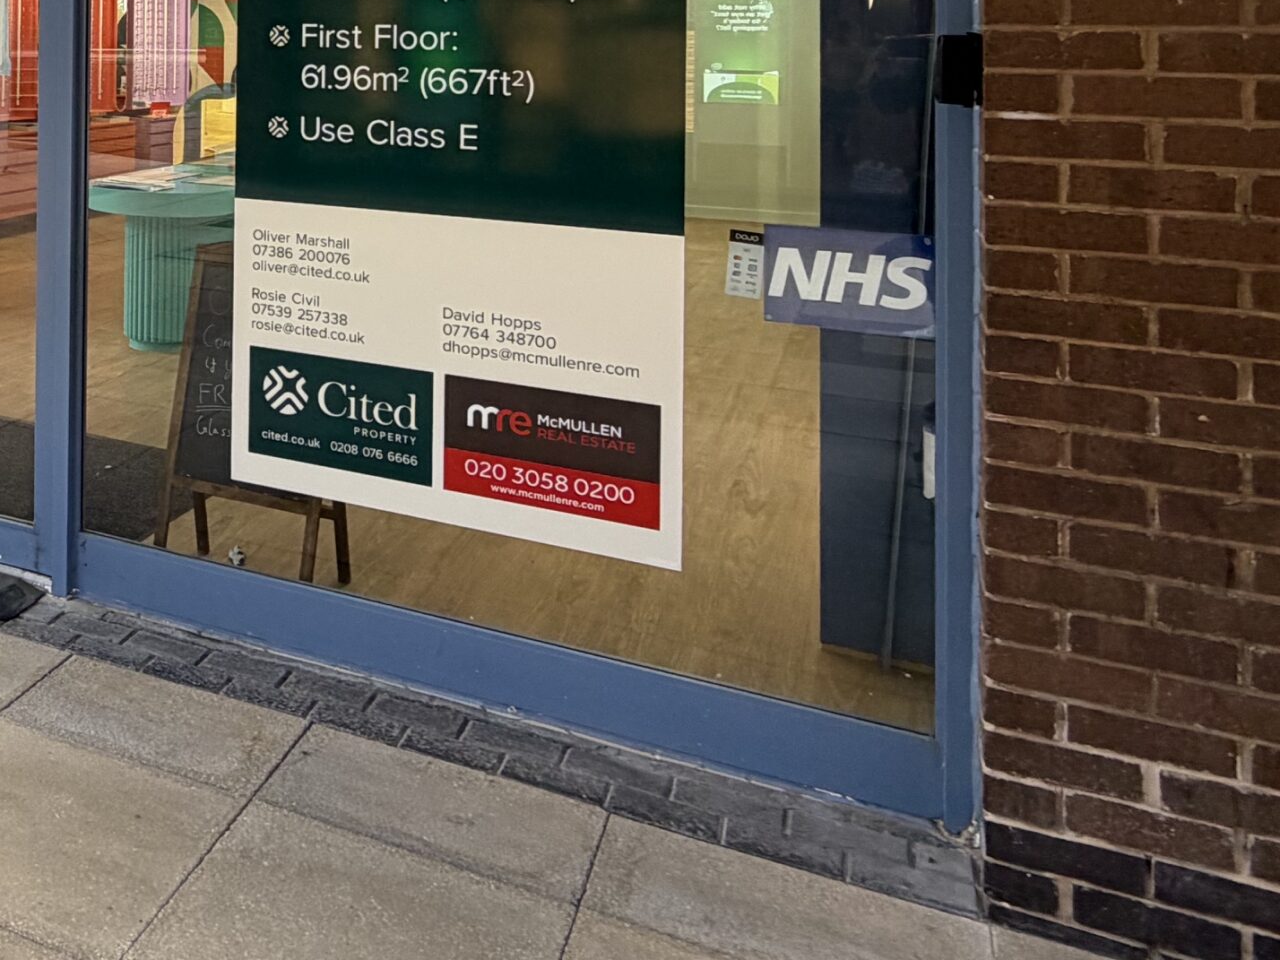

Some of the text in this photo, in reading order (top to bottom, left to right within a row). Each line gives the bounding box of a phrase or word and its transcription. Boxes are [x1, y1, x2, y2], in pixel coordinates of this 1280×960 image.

[301, 23, 459, 51] First Floor:
[300, 63, 535, 104] 61.96m² (667ft²)
[299, 115, 479, 151] Use Class E
[252, 228, 350, 250] Oliver Marshall
[252, 243, 351, 266] 07386 200076
[252, 260, 371, 284] oliver@cited.co.uk
[767, 246, 933, 311] NHS
[251, 287, 320, 307] Rosie Civil
[251, 302, 348, 326] 07539 257338
[442, 306, 542, 331] David Hopps
[251, 320, 365, 344] rosie@cited.co.uk
[442, 323, 557, 350] 07764 348700
[442, 340, 640, 379] dhopps@mcmullenre.com
[317, 381, 419, 431] Cited
[466, 403, 533, 436] mre
[353, 426, 417, 446] PROPERTY
[536, 414, 623, 439] McMULLEN
[261, 429, 419, 467] cited.co.uk 0208 076 6666
[536, 429, 636, 455] REAL ESTATE
[464, 458, 635, 505] 020 3058 0200
[490, 484, 605, 513] www.mcmullenre.com
